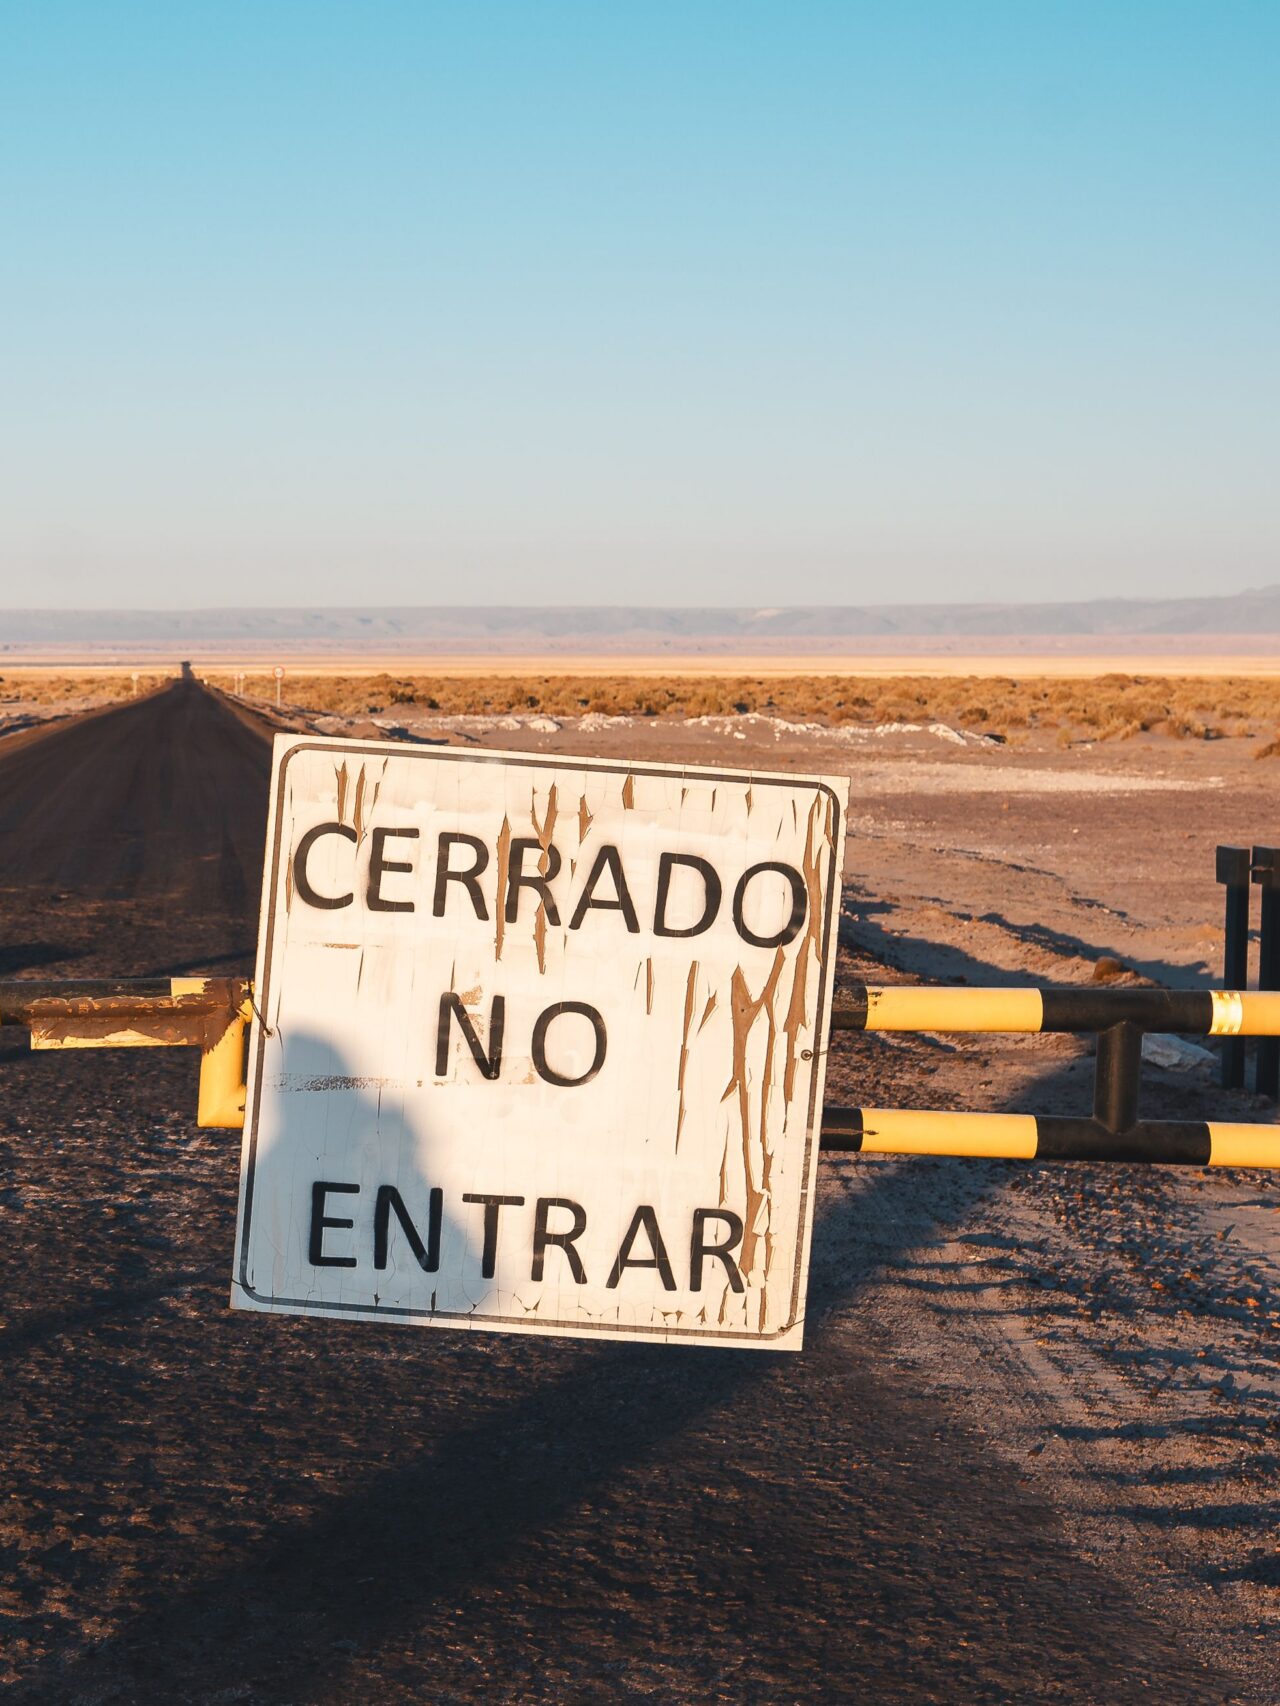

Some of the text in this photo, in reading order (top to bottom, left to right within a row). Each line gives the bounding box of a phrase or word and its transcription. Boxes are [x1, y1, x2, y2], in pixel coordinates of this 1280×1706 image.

[294, 822, 808, 948] CERRADO
[435, 992, 608, 1087] NO
[308, 1181, 745, 1293] ENTRAR
